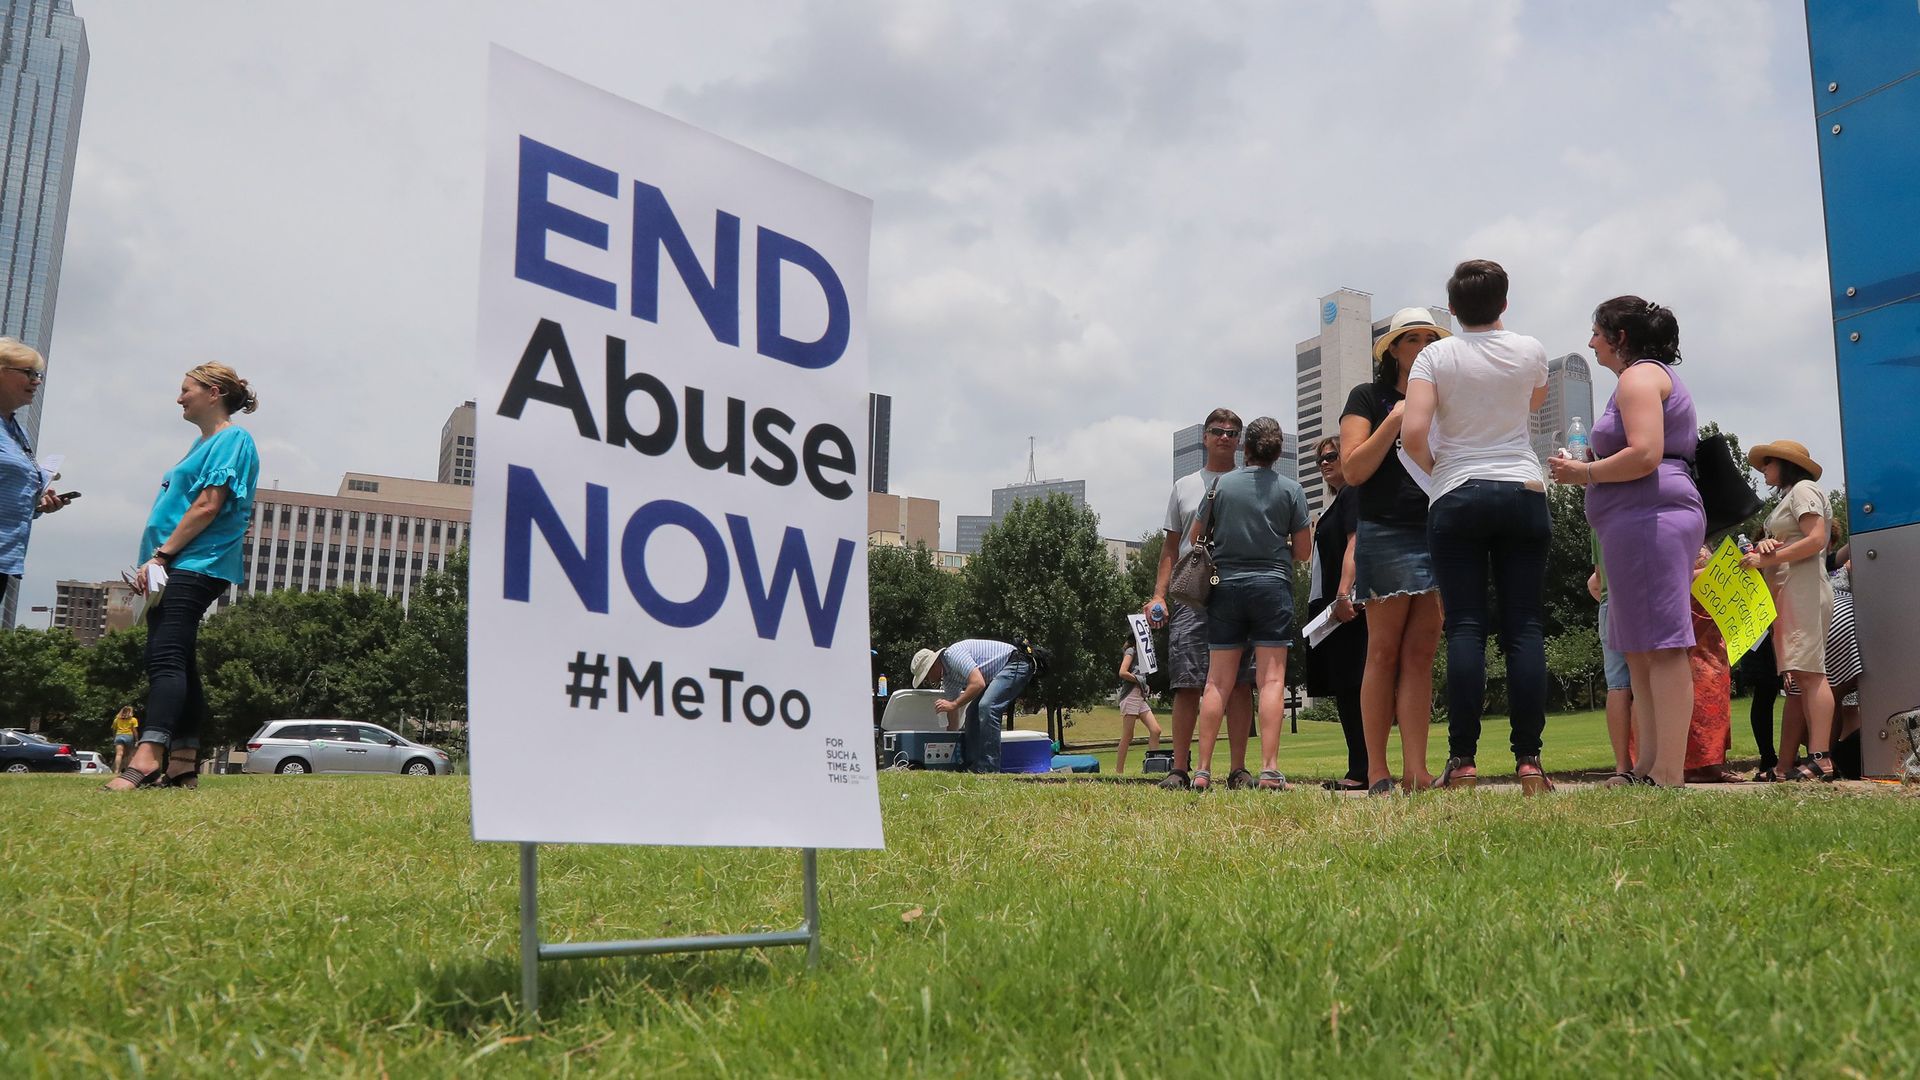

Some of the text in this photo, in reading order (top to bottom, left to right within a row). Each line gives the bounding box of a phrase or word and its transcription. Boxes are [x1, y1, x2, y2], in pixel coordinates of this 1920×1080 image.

[515, 134, 850, 369] END
[496, 318, 856, 500] Abuse
[503, 464, 856, 648] NOW
[1721, 545, 1760, 600] Protect
[1709, 564, 1732, 591] not
[1699, 583, 1727, 616] snap
[1135, 620, 1156, 669] END
[565, 651, 811, 729] #MeToo
[826, 738, 843, 747] FOR
[826, 750, 857, 760] SUCH A
[827, 762, 861, 772] TIME AS
[829, 774, 848, 783] THIS
